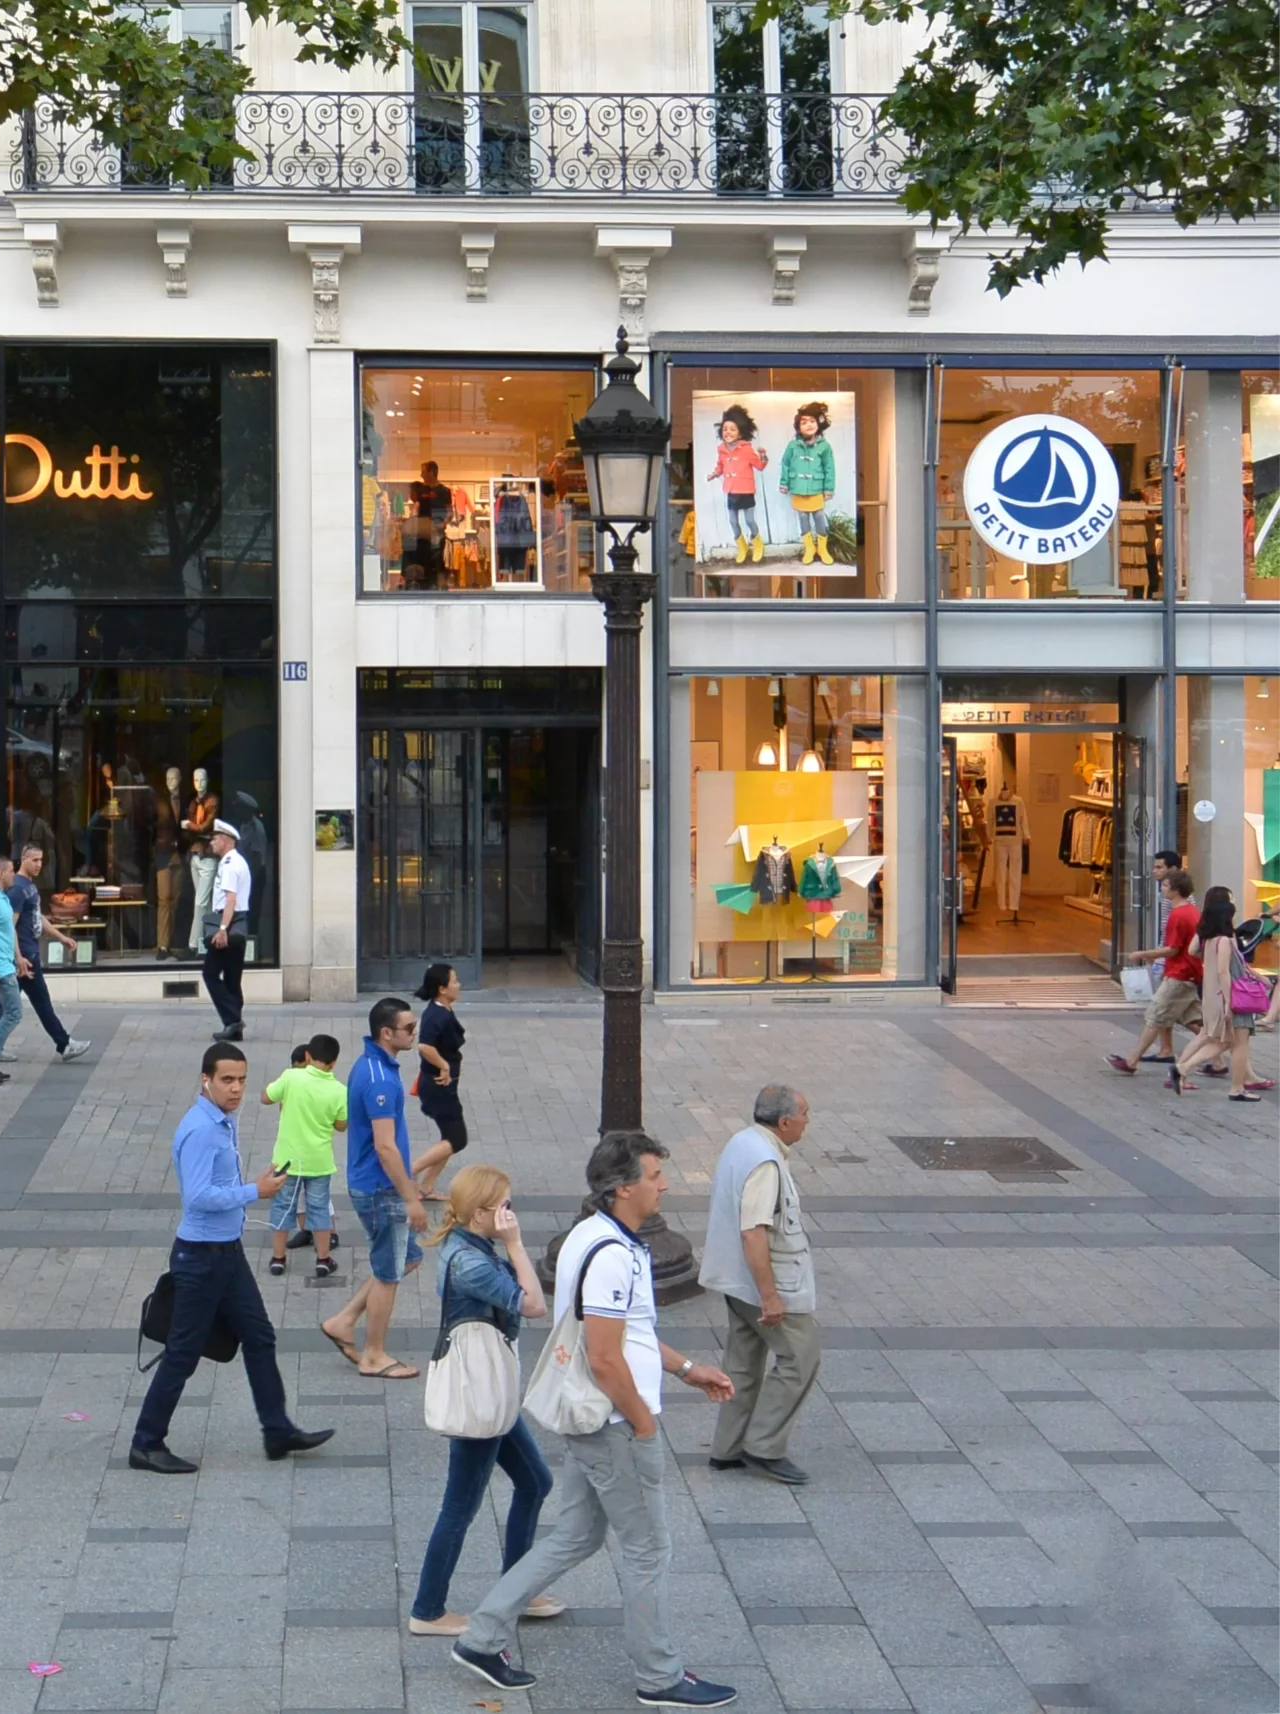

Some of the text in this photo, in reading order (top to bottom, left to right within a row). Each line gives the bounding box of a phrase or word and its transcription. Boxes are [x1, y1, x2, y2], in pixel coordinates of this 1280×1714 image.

[973, 502, 1114, 554] PETIT BATEAU
[284, 663, 307, 680] 116
[966, 710, 1087, 722] PETIT BATEAU
